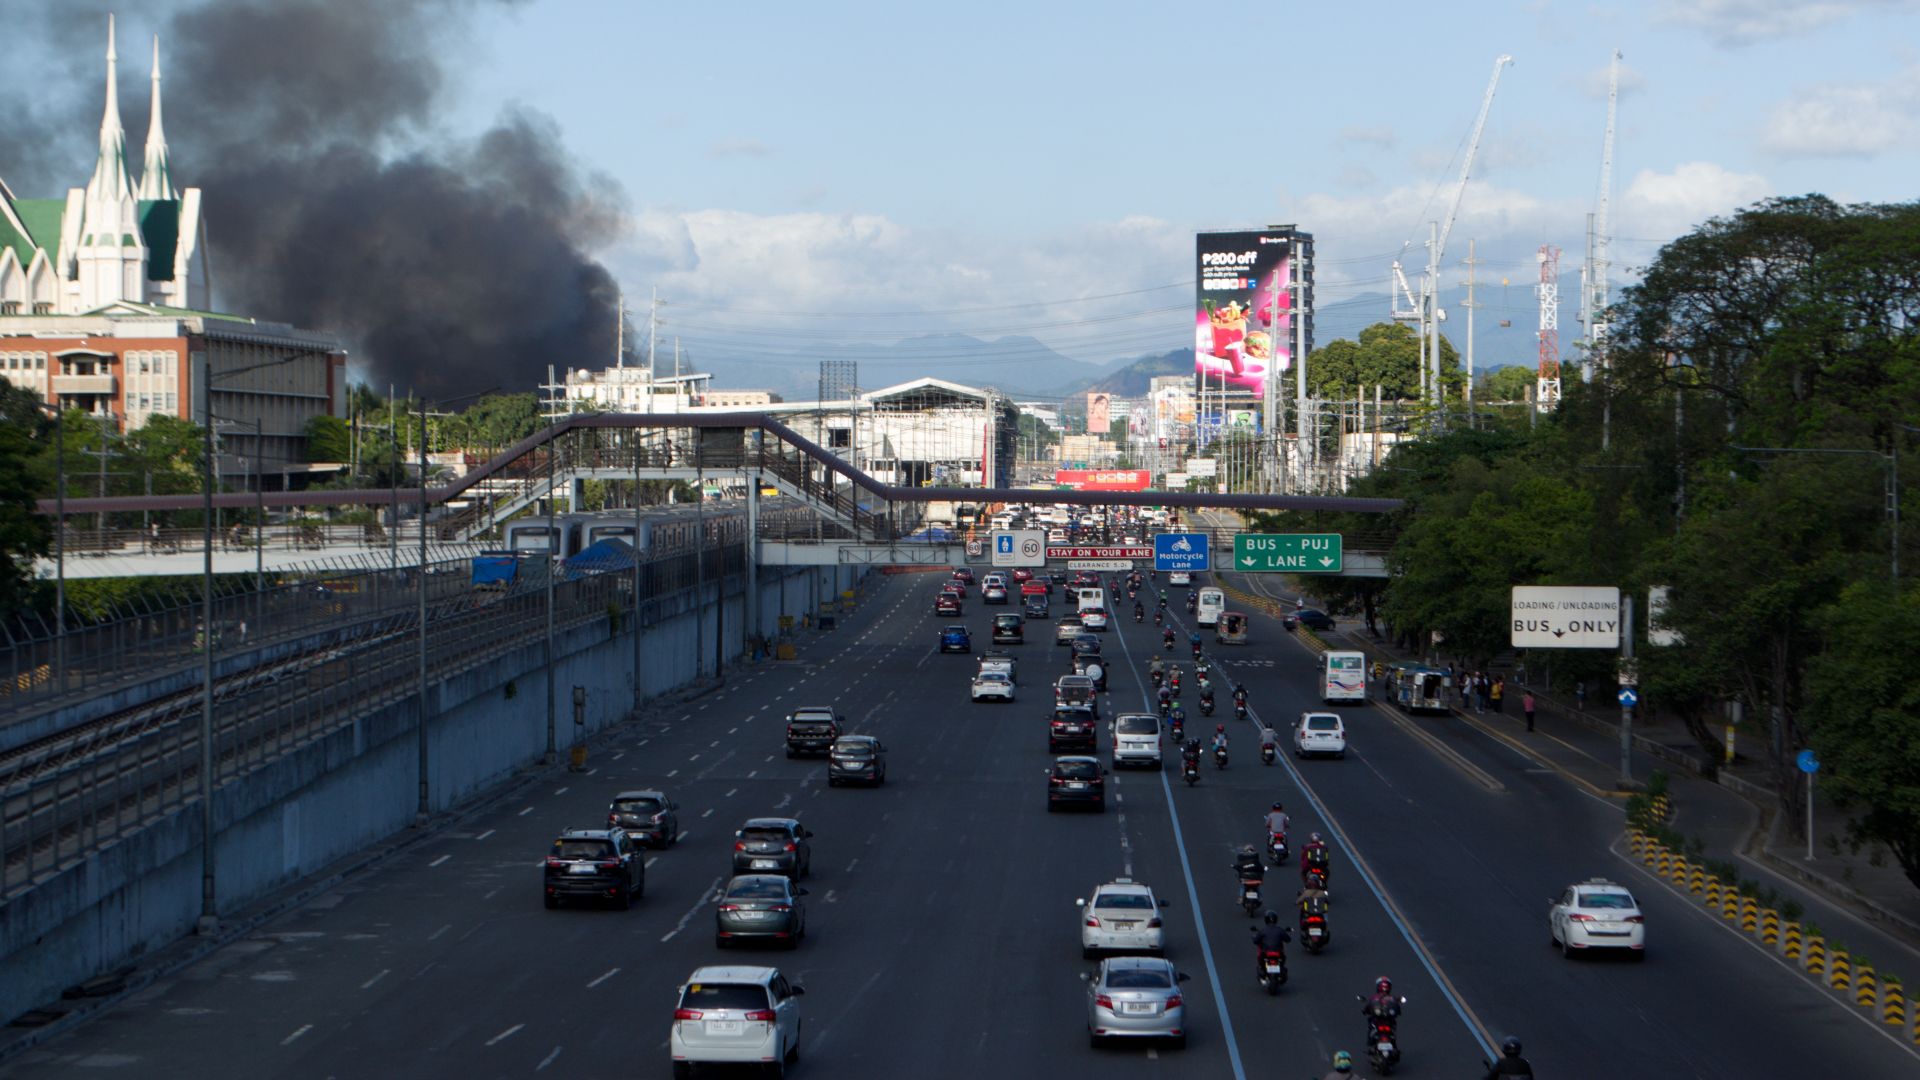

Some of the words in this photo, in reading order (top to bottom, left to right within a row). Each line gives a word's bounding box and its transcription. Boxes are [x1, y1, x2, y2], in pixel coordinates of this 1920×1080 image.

[1237, 251, 1257, 264] off
[1024, 543, 1038, 553] 60
[1246, 538, 1276, 550] BUS
[1301, 538, 1329, 550] PUJ
[1050, 549, 1073, 557] STAY
[1159, 553, 1204, 562] Motorcycle
[1267, 555, 1307, 567] LANE
[1514, 601, 1555, 610] LOADING
[1563, 601, 1617, 610] UNLOADING
[1514, 620, 1550, 632] BUS
[1568, 620, 1617, 633] ONLY
